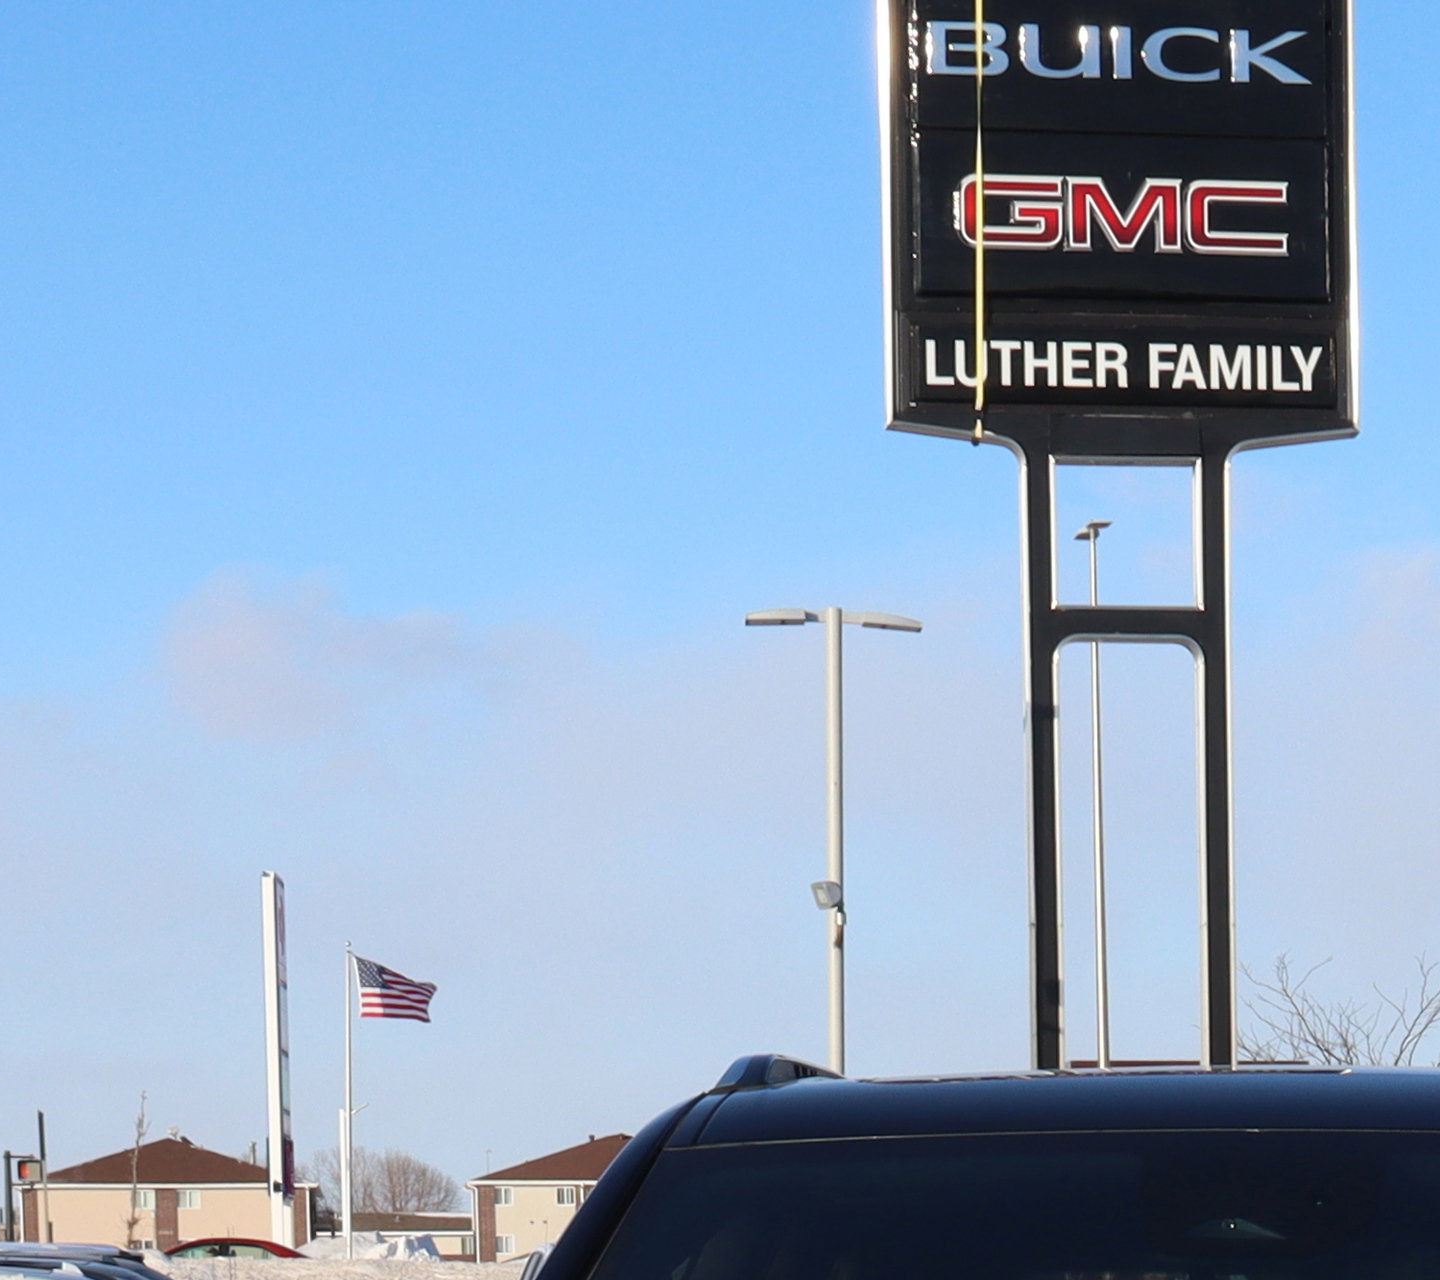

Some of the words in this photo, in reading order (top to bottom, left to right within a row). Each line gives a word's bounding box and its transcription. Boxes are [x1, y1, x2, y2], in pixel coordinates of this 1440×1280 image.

[925, 20, 1313, 85] BUICK
[953, 173, 1290, 257] GMC
[924, 338, 1129, 388] LUTHER
[1148, 342, 1323, 392] FAMILY
